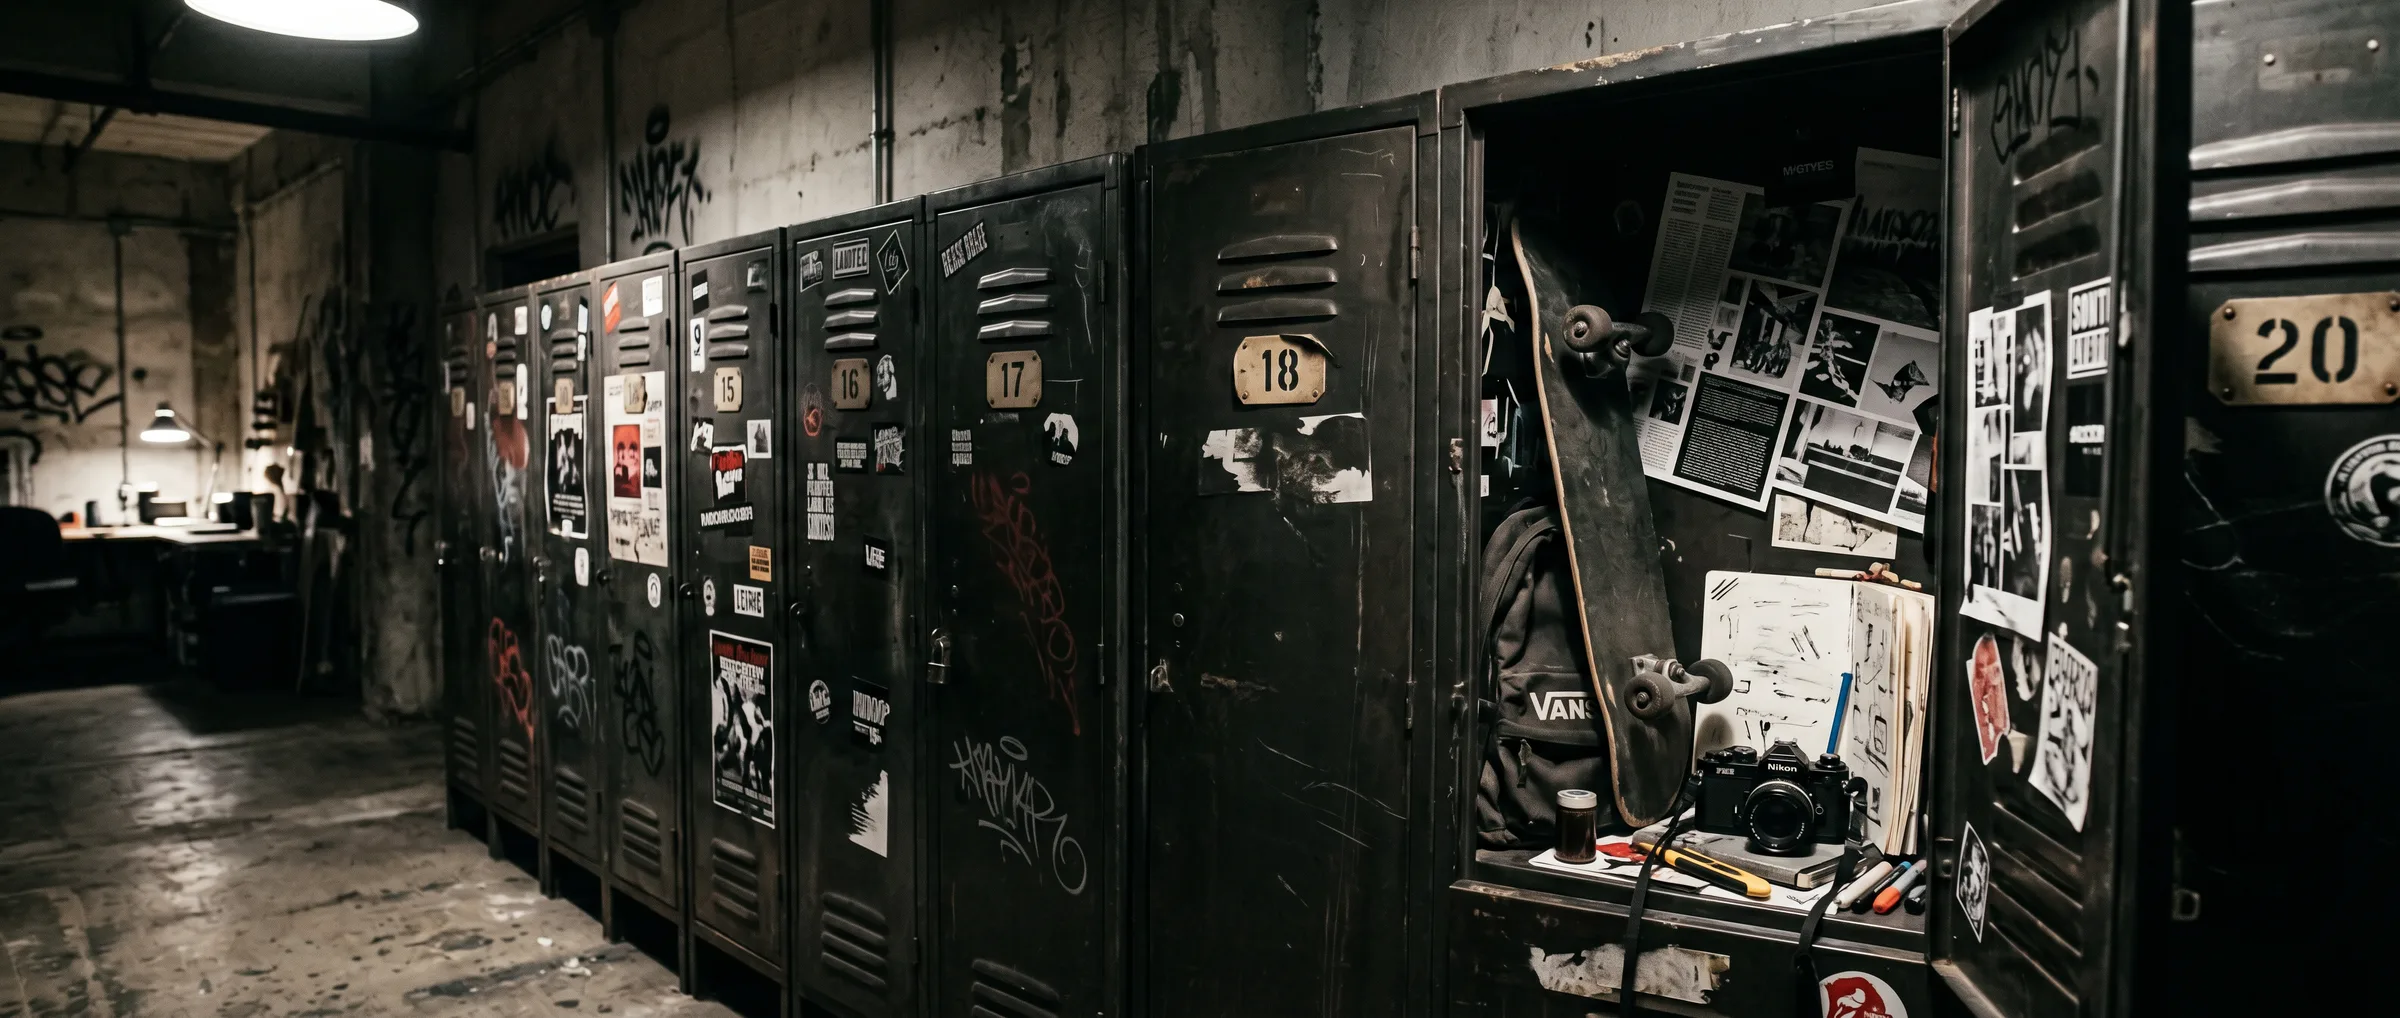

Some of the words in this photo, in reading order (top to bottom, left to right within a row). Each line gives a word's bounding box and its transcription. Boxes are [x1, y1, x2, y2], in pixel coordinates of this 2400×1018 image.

[2255, 315, 2359, 386] 20
[841, 368, 859, 401] 16
[1000, 361, 1025, 399] 17
[1261, 348, 1299, 393] 18
[721, 375, 735, 403] 15
[1529, 691, 1597, 721] VANS
[1767, 763, 1798, 773] Nikon
